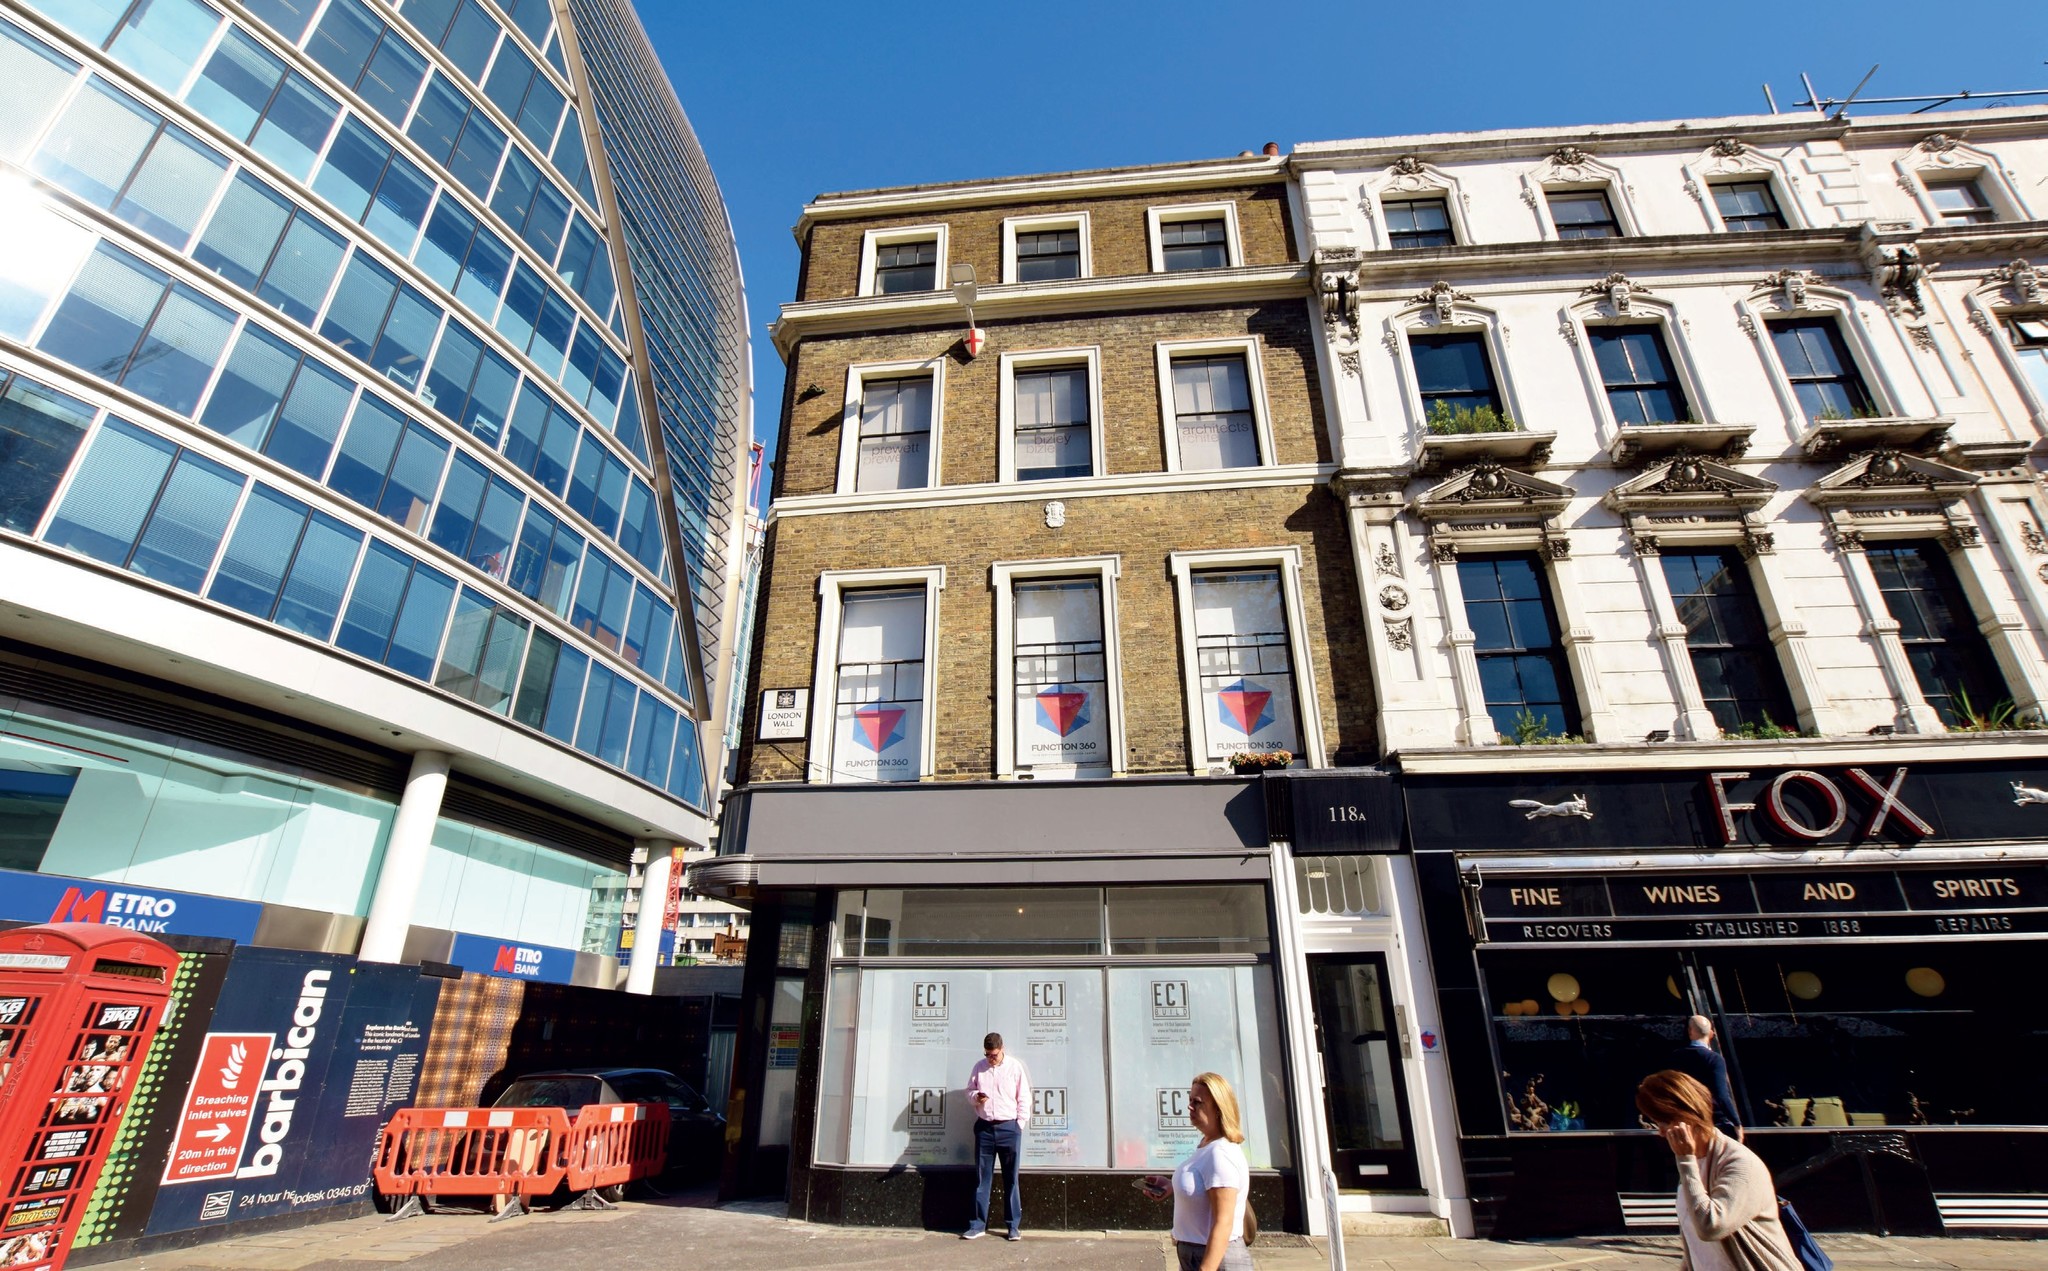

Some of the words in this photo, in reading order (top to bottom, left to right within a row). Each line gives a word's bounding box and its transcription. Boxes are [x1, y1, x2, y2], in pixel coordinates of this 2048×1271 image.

[1182, 421, 1249, 435] architects
[1034, 431, 1072, 445] bizley
[871, 442, 920, 456] prewett
[767, 712, 802, 720] LONDON
[1031, 743, 1078, 751] FUNCTION
[1079, 742, 1096, 750] 360
[1217, 742, 1264, 750] FUNCTION
[1266, 741, 1283, 749] 360
[845, 759, 891, 768] FUNCTION
[892, 758, 909, 766] 360
[1706, 767, 1935, 841] FOX
[1510, 888, 1562, 906] FINE
[1642, 885, 1721, 904] WINES
[1803, 882, 1856, 900] AND
[1933, 878, 2020, 898] SPIRITS
[1522, 924, 1612, 938] RECOVERS
[1686, 921, 1799, 937] STABLISHED
[1823, 920, 1862, 934] 1868
[1934, 917, 2012, 933] REPAIRS
[514, 963, 539, 975] BANK
[915, 984, 947, 1007] EC1
[1031, 983, 1063, 1007] EC1
[1153, 983, 1187, 1007] EC1
[1031, 1008, 1064, 1016] BUILD
[1154, 1008, 1188, 1016] BUILD
[117, 1020, 133, 1030] 17
[235, 969, 332, 1180] barbican
[195, 1094, 249, 1106] Breaching
[911, 1089, 944, 1114] EC1
[1032, 1090, 1065, 1115] EC1
[188, 1110, 213, 1120] inlet
[214, 1108, 247, 1118] valves
[910, 1116, 944, 1124] BUILD
[1032, 1117, 1065, 1125] BUILD
[1160, 1118, 1187, 1126] BUIL
[178, 1150, 201, 1160] 20m
[204, 1147, 215, 1157] in
[217, 1146, 237, 1156] this
[179, 1161, 227, 1175] direction
[239, 1195, 255, 1207] 24
[256, 1192, 282, 1205] hour
[282, 1189, 325, 1207] helpdesk
[326, 1186, 351, 1199] 0345
